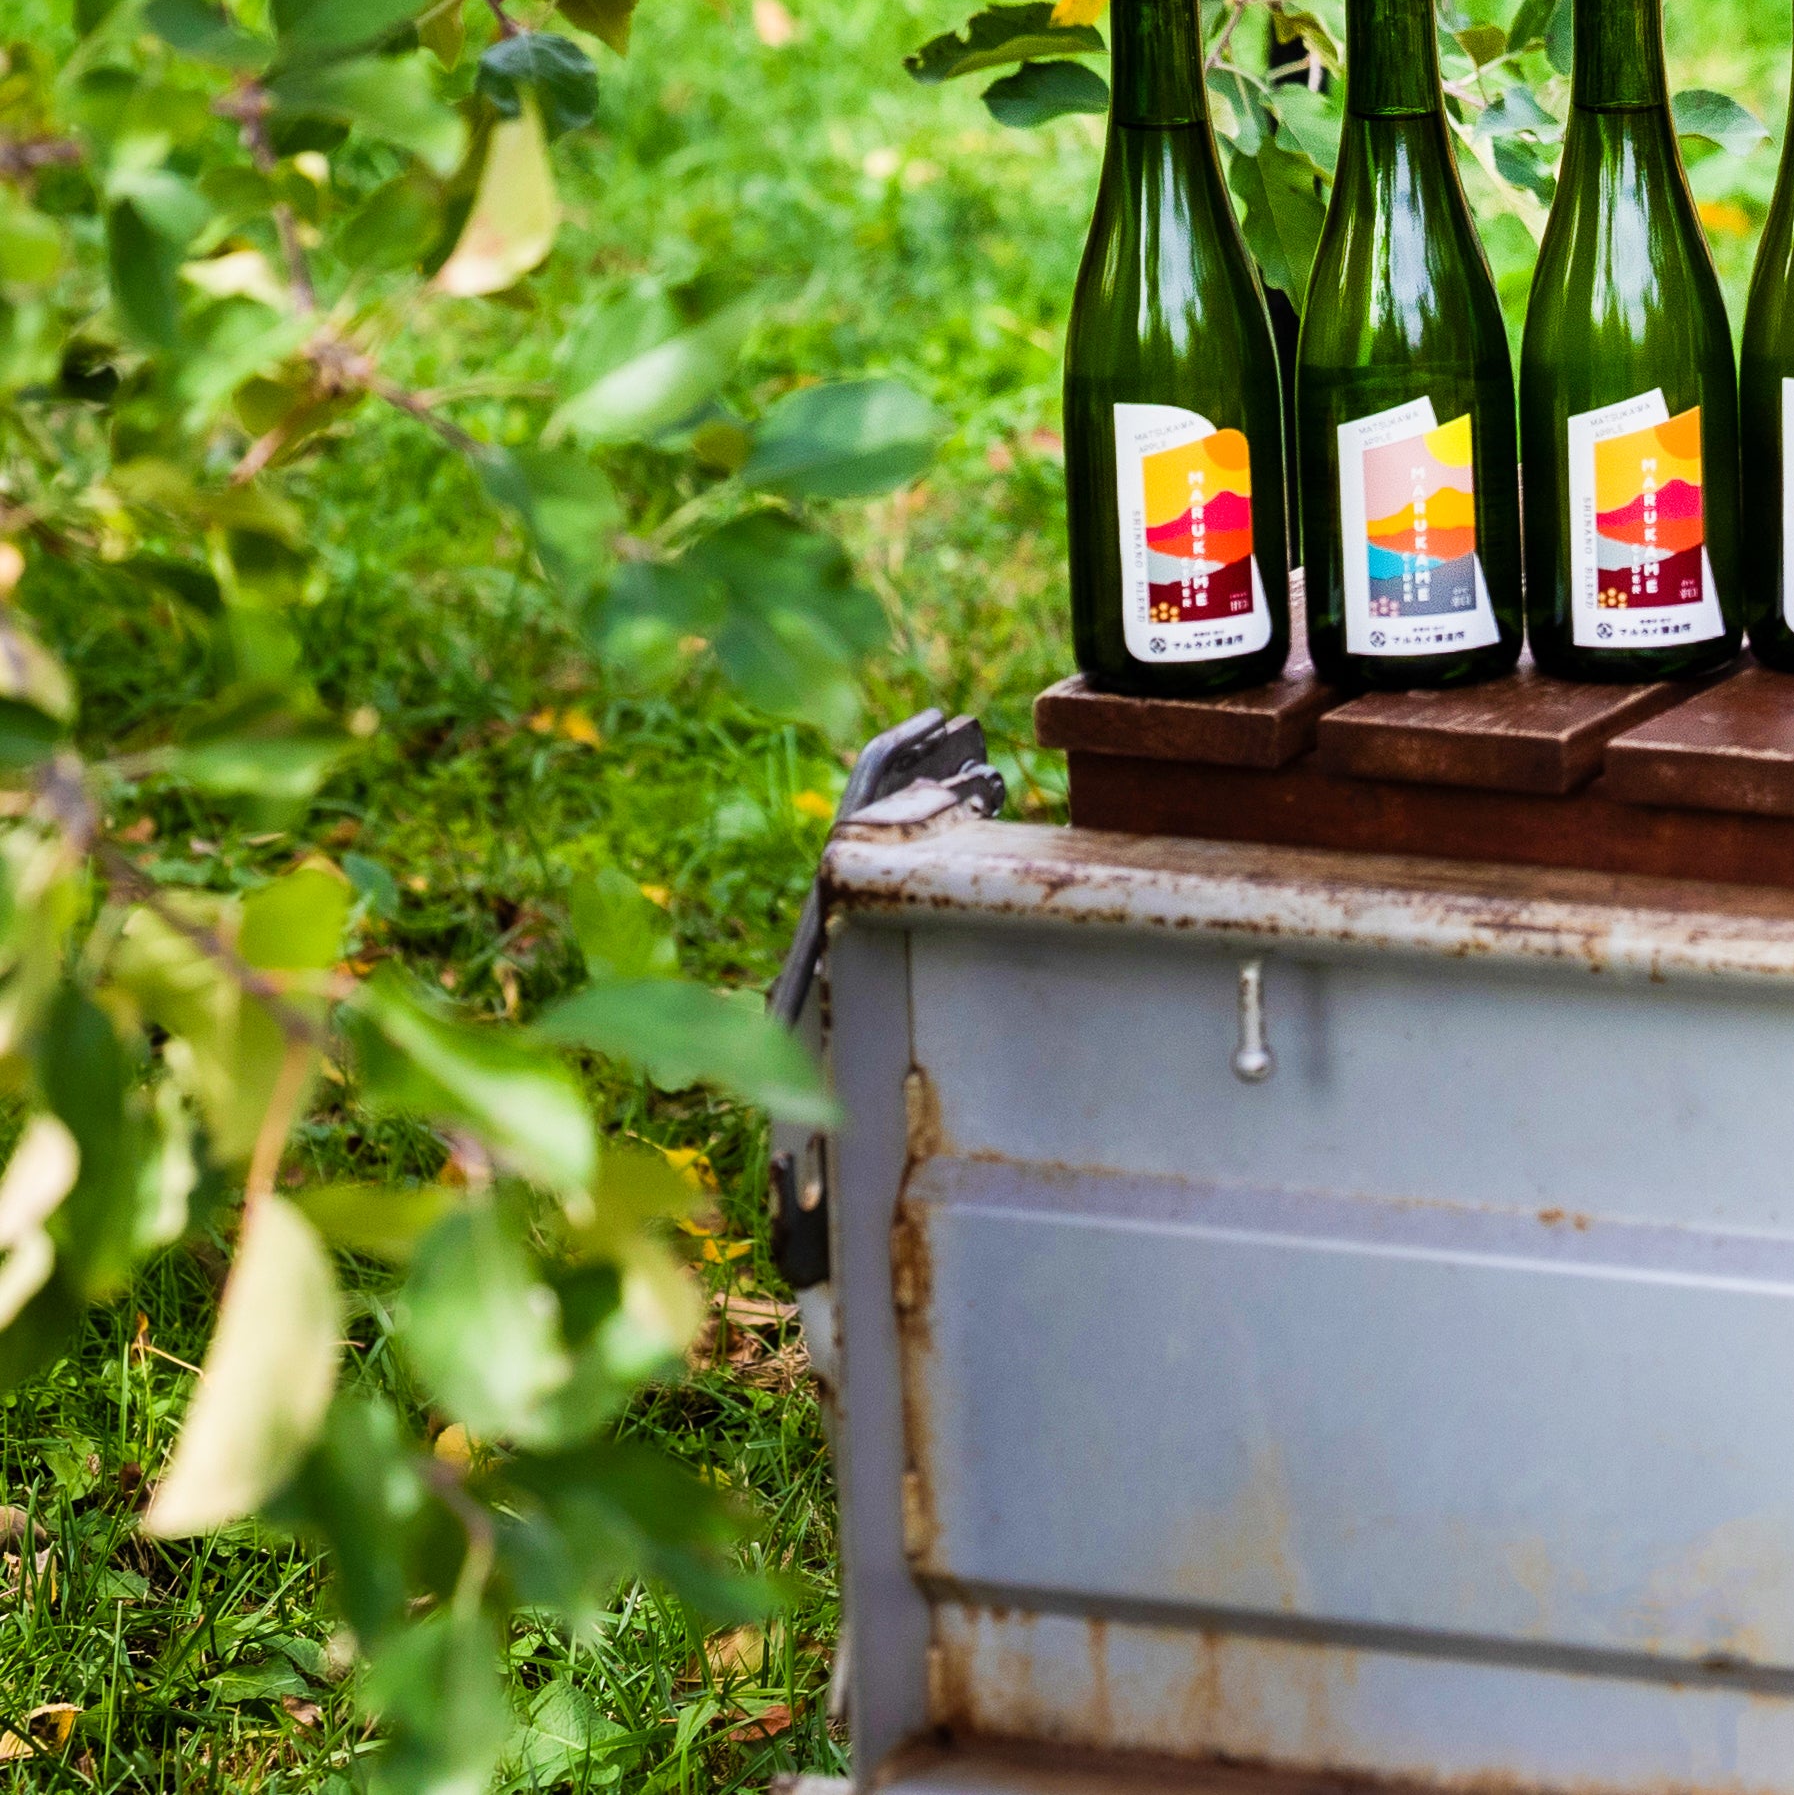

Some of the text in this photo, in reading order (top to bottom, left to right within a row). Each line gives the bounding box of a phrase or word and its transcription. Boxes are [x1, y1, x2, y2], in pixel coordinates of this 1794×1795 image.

[1187, 470, 1209, 607] MARUKAME
[1410, 466, 1432, 602] MARUKAME
[1641, 457, 1660, 594] MARUKAME
